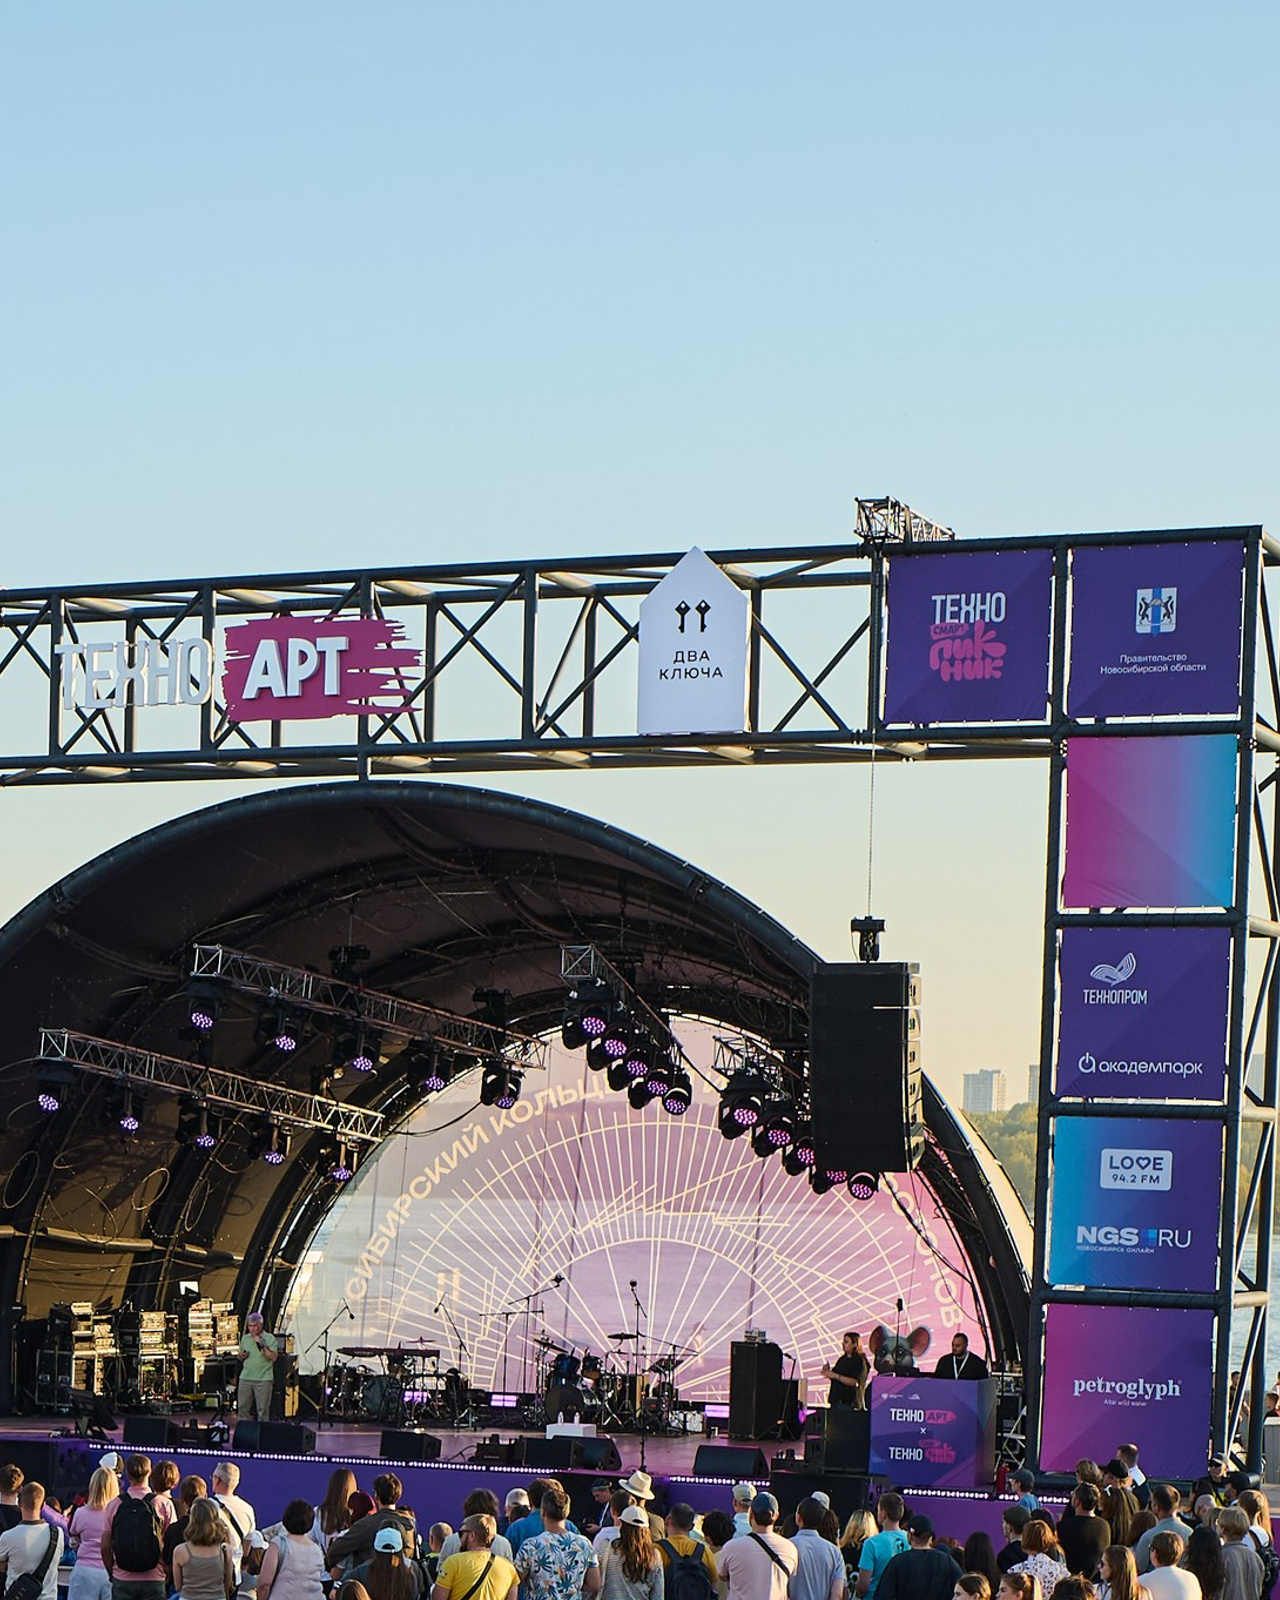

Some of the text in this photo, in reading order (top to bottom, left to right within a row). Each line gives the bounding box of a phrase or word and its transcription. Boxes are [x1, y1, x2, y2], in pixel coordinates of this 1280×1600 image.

[931, 591, 1007, 625] ТЕХНО
[673, 650, 710, 664] ДВА
[1120, 654, 1188, 665] Правительство
[54, 636, 350, 709] ТЕХНО АРТ
[659, 667, 723, 680] КЛЮЧА
[1100, 663, 1207, 674] Новосибирской области
[1083, 988, 1148, 1005] ТЕХНОПРОМ
[1099, 1060, 1203, 1079] академпарк
[1112, 1173, 1160, 1184] 94.2 FM
[345, 1121, 490, 1300] СИБИРСКИЙ
[1076, 1225, 1192, 1249] NGS RU
[1073, 1376, 1181, 1400] petroglyph
[890, 1408, 924, 1422] ТЕХНО
[889, 1447, 923, 1461] ТЕХНО
